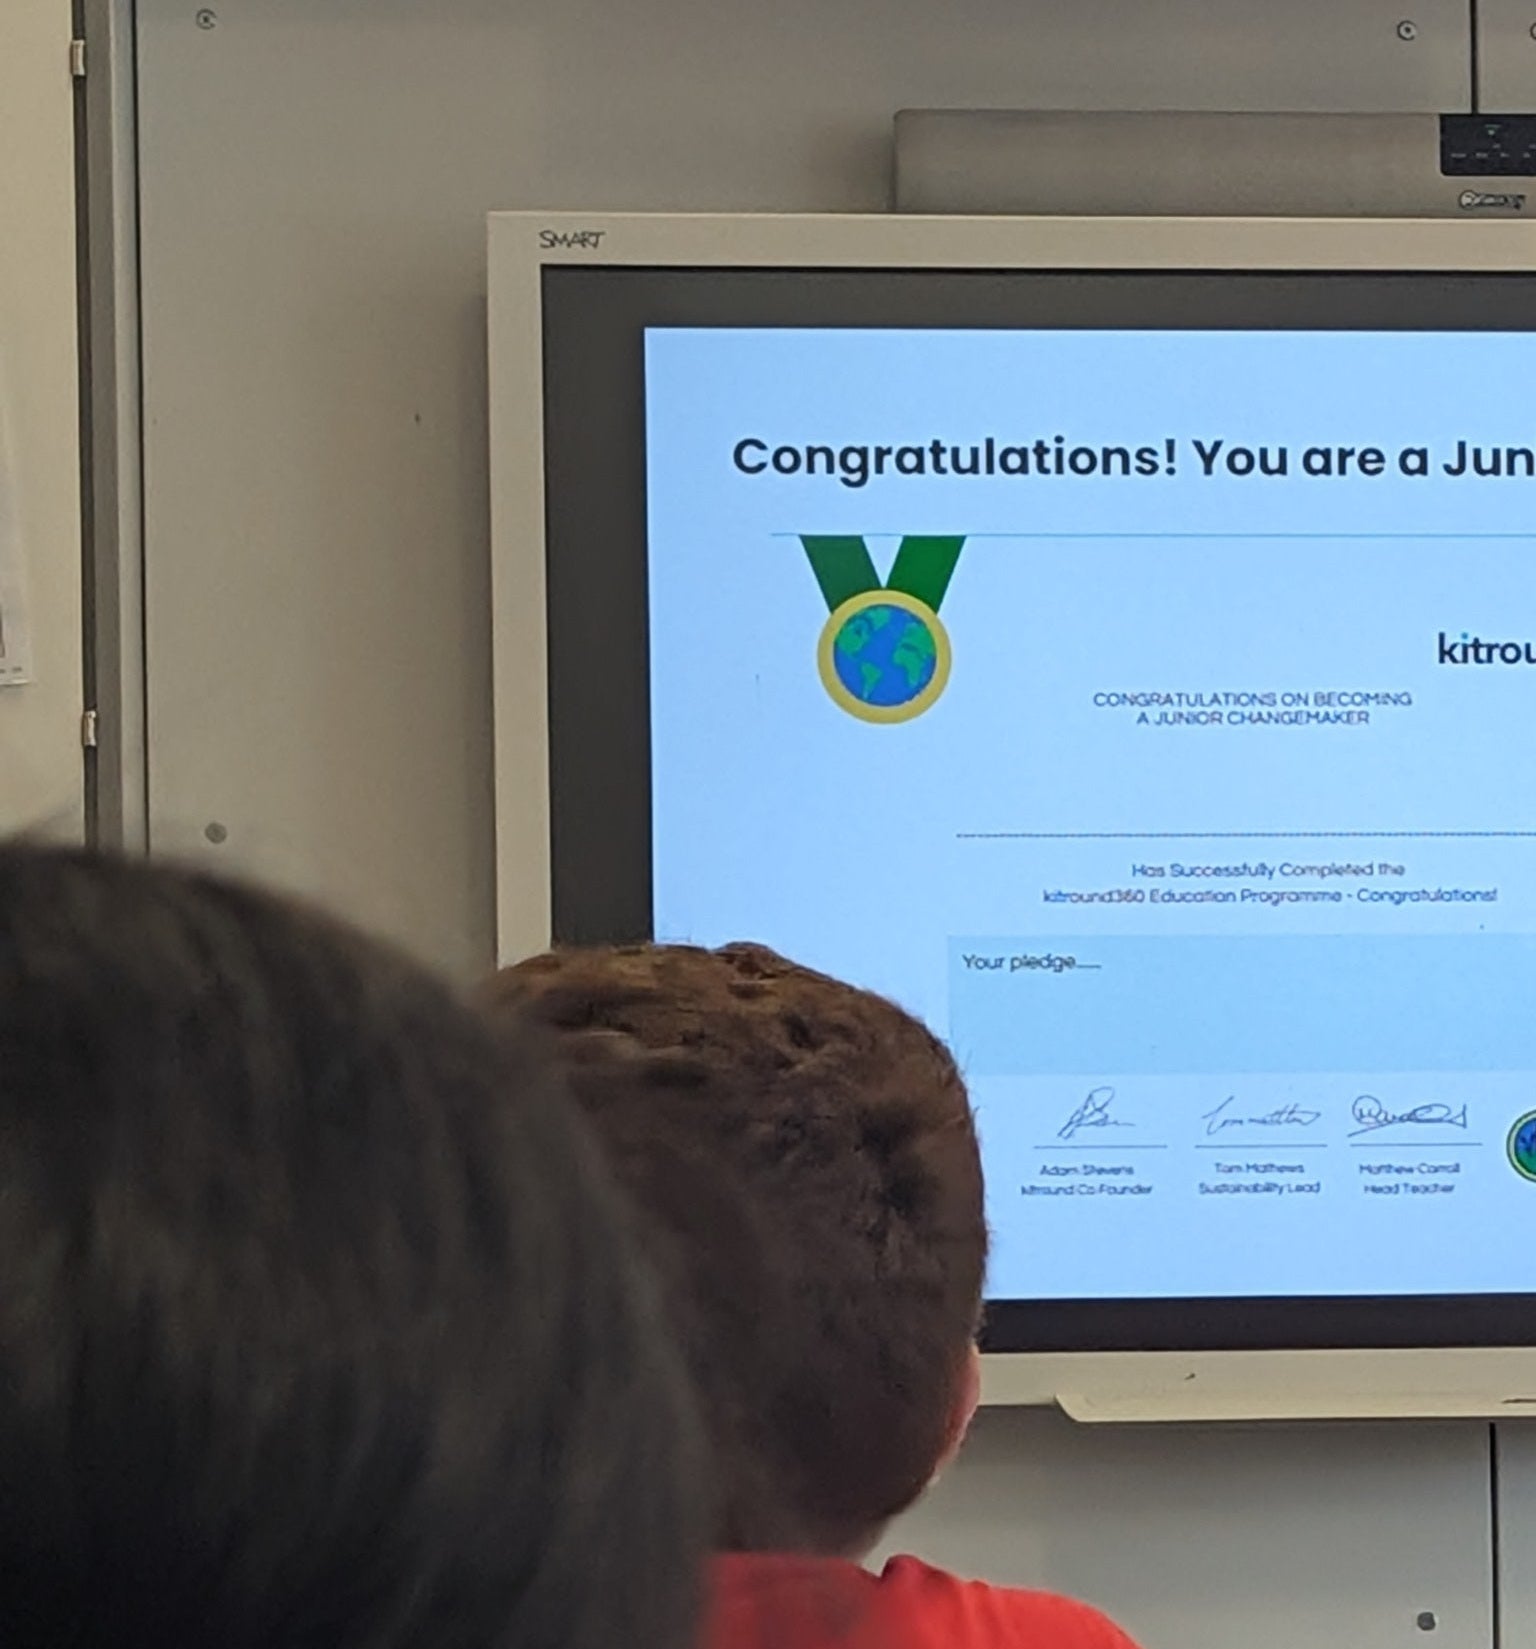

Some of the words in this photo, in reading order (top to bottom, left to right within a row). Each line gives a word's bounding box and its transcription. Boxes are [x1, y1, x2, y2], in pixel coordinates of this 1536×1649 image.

[539, 229, 606, 249] SMART
[733, 435, 1176, 488] Congratulations!
[1192, 440, 1287, 476] You
[1303, 447, 1385, 476] are
[1399, 448, 1428, 476] a
[1093, 692, 1277, 707] CONGRATULATIONS
[1281, 692, 1309, 707] ON
[1314, 692, 1412, 707] BECOMING
[1136, 712, 1149, 725] A
[1154, 711, 1223, 726] JUNIOR
[1227, 710, 1370, 725] CHANGEMAKER
[1132, 864, 1165, 877] Has
[1170, 863, 1275, 880] Successfully
[1279, 862, 1374, 879] Completed
[1378, 863, 1405, 876] the
[1043, 889, 1145, 903] kitround360
[1150, 889, 1237, 903] Education
[1240, 888, 1342, 906] Programme
[1357, 888, 1497, 906] Congratulations!
[962, 955, 1005, 970] Your
